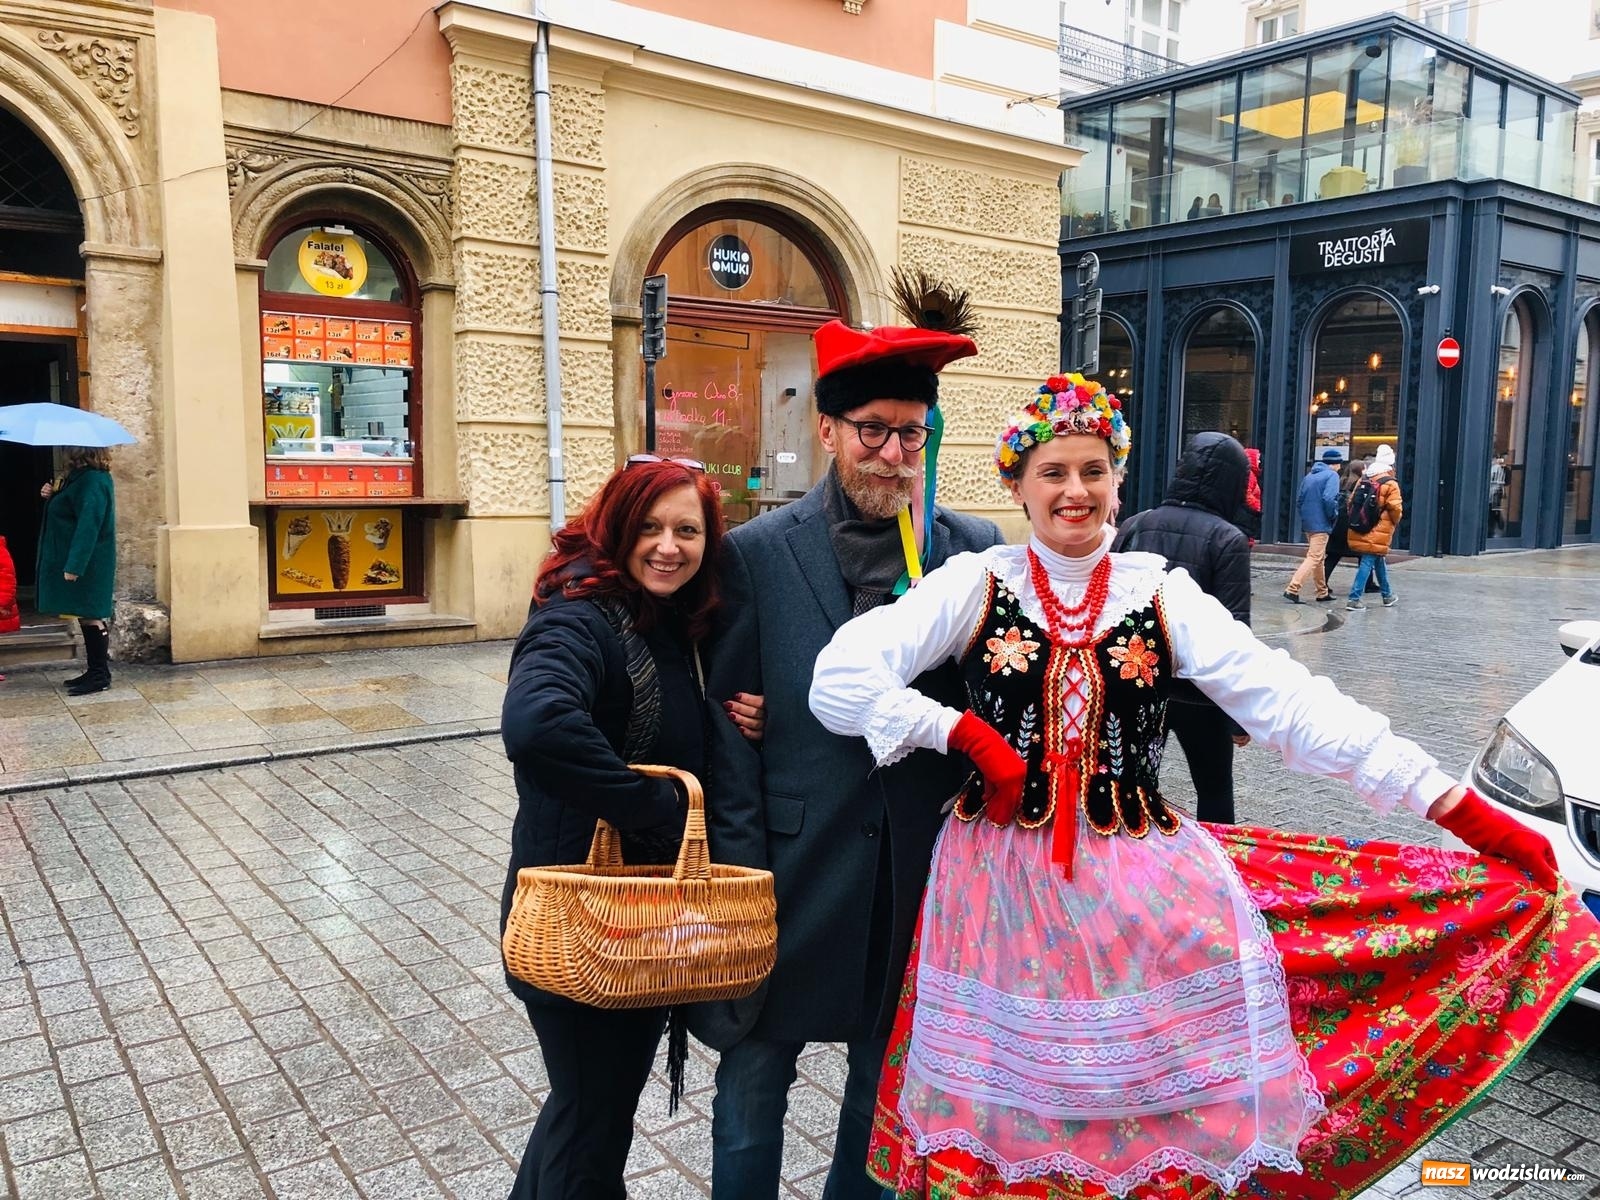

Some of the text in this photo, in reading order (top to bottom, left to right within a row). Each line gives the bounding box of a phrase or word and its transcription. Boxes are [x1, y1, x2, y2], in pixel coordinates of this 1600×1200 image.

[307, 241, 344, 252] Falafel
[1318, 228, 1396, 255] TRATTORIA
[713, 247, 741, 262] HUKI
[1324, 246, 1385, 268] DEGUSTI
[720, 260, 750, 276] MUKI
[325, 280, 334, 289] 13
[703, 462, 742, 475] UKI CLUB
